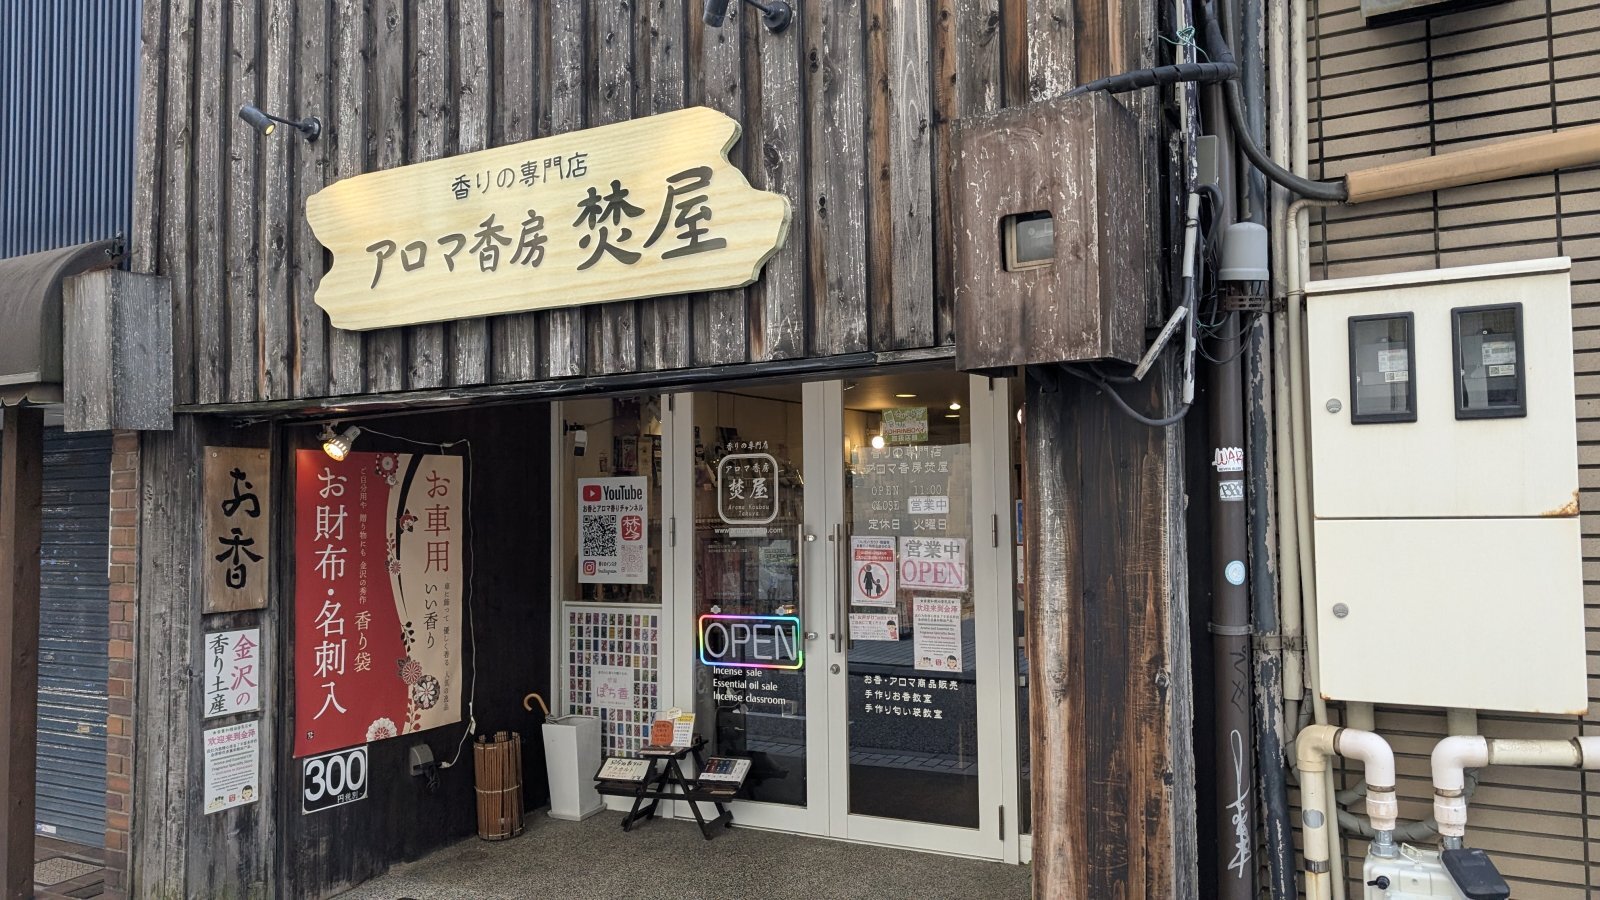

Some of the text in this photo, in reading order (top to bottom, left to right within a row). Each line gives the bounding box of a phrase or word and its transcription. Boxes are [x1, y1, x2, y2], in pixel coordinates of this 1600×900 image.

[451, 152, 589, 200] 香りの専門店
[366, 165, 727, 289] アロマ香房 焚屋
[727, 441, 769, 451] 香りの専門店
[725, 463, 770, 474] アロマ香房
[603, 485, 643, 500] YouTube
[728, 478, 769, 500] 焚屋
[871, 485, 900, 496] OPEN
[911, 499, 947, 511] 営業中
[215, 468, 264, 590] お香
[423, 469, 451, 574] お車用
[869, 519, 947, 530] 定休日 火曜日
[905, 540, 960, 559] 営業中
[902, 560, 965, 585] OPEN
[313, 467, 347, 720] お財布・名刺入
[424, 583, 438, 649] いい香り
[354, 611, 372, 672] 香り袋
[704, 622, 797, 661] OPEN
[207, 633, 230, 715] 香り土産
[231, 633, 258, 707] 金沢の
[713, 666, 762, 677] Incense sale
[713, 679, 778, 691] Essential oil sale
[864, 675, 959, 691] お香・アロマ商品販売
[713, 692, 786, 706] Incense classroom
[864, 689, 932, 704] 手作りお香教室
[304, 750, 366, 802] 300
